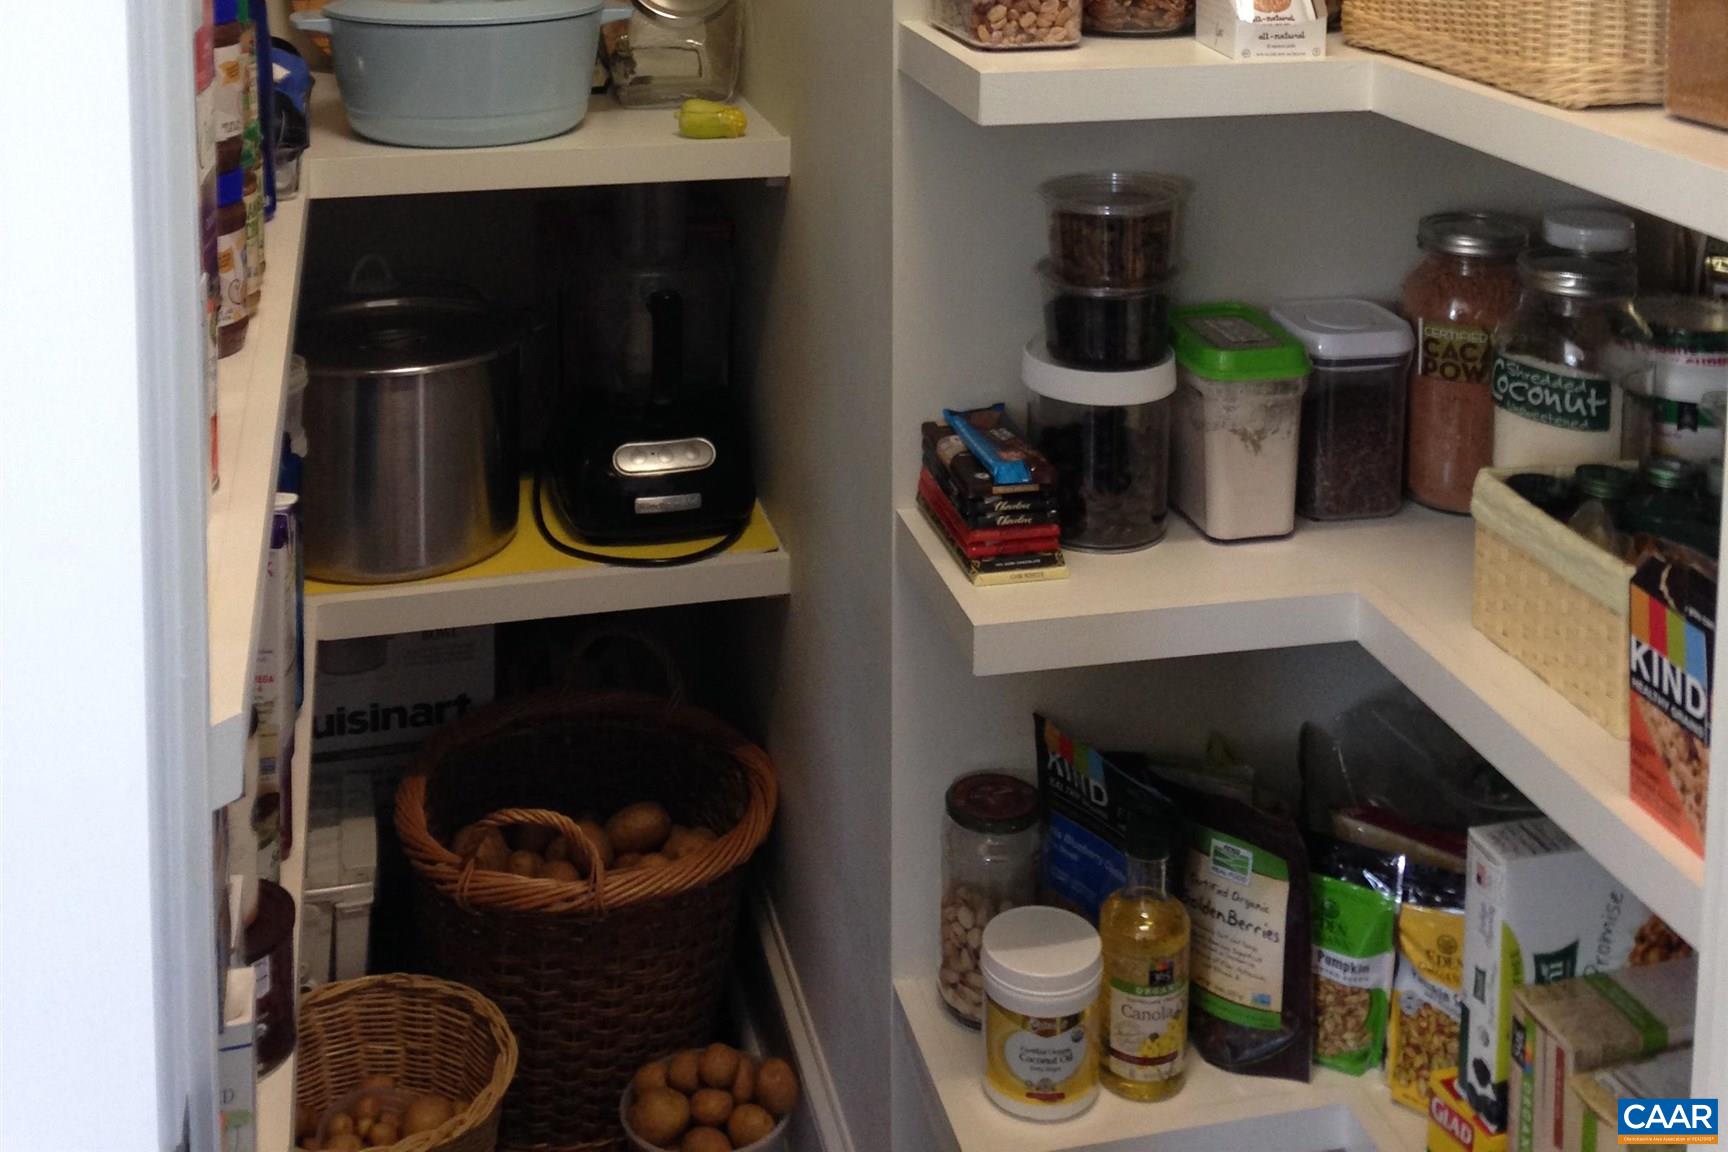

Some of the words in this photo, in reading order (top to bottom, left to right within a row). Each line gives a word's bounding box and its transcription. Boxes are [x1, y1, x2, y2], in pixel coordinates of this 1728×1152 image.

[1258, 30, 1306, 41] all-natural
[1424, 327, 1489, 344] CERTIFIED
[1494, 358, 1608, 417] Coconut
[1630, 634, 1706, 719] KIND
[1048, 751, 1109, 808] KIND
[1317, 949, 1371, 973] Pumpkin
[1121, 1004, 1174, 1021] Canola
[1431, 1096, 1473, 1145] GLAD
